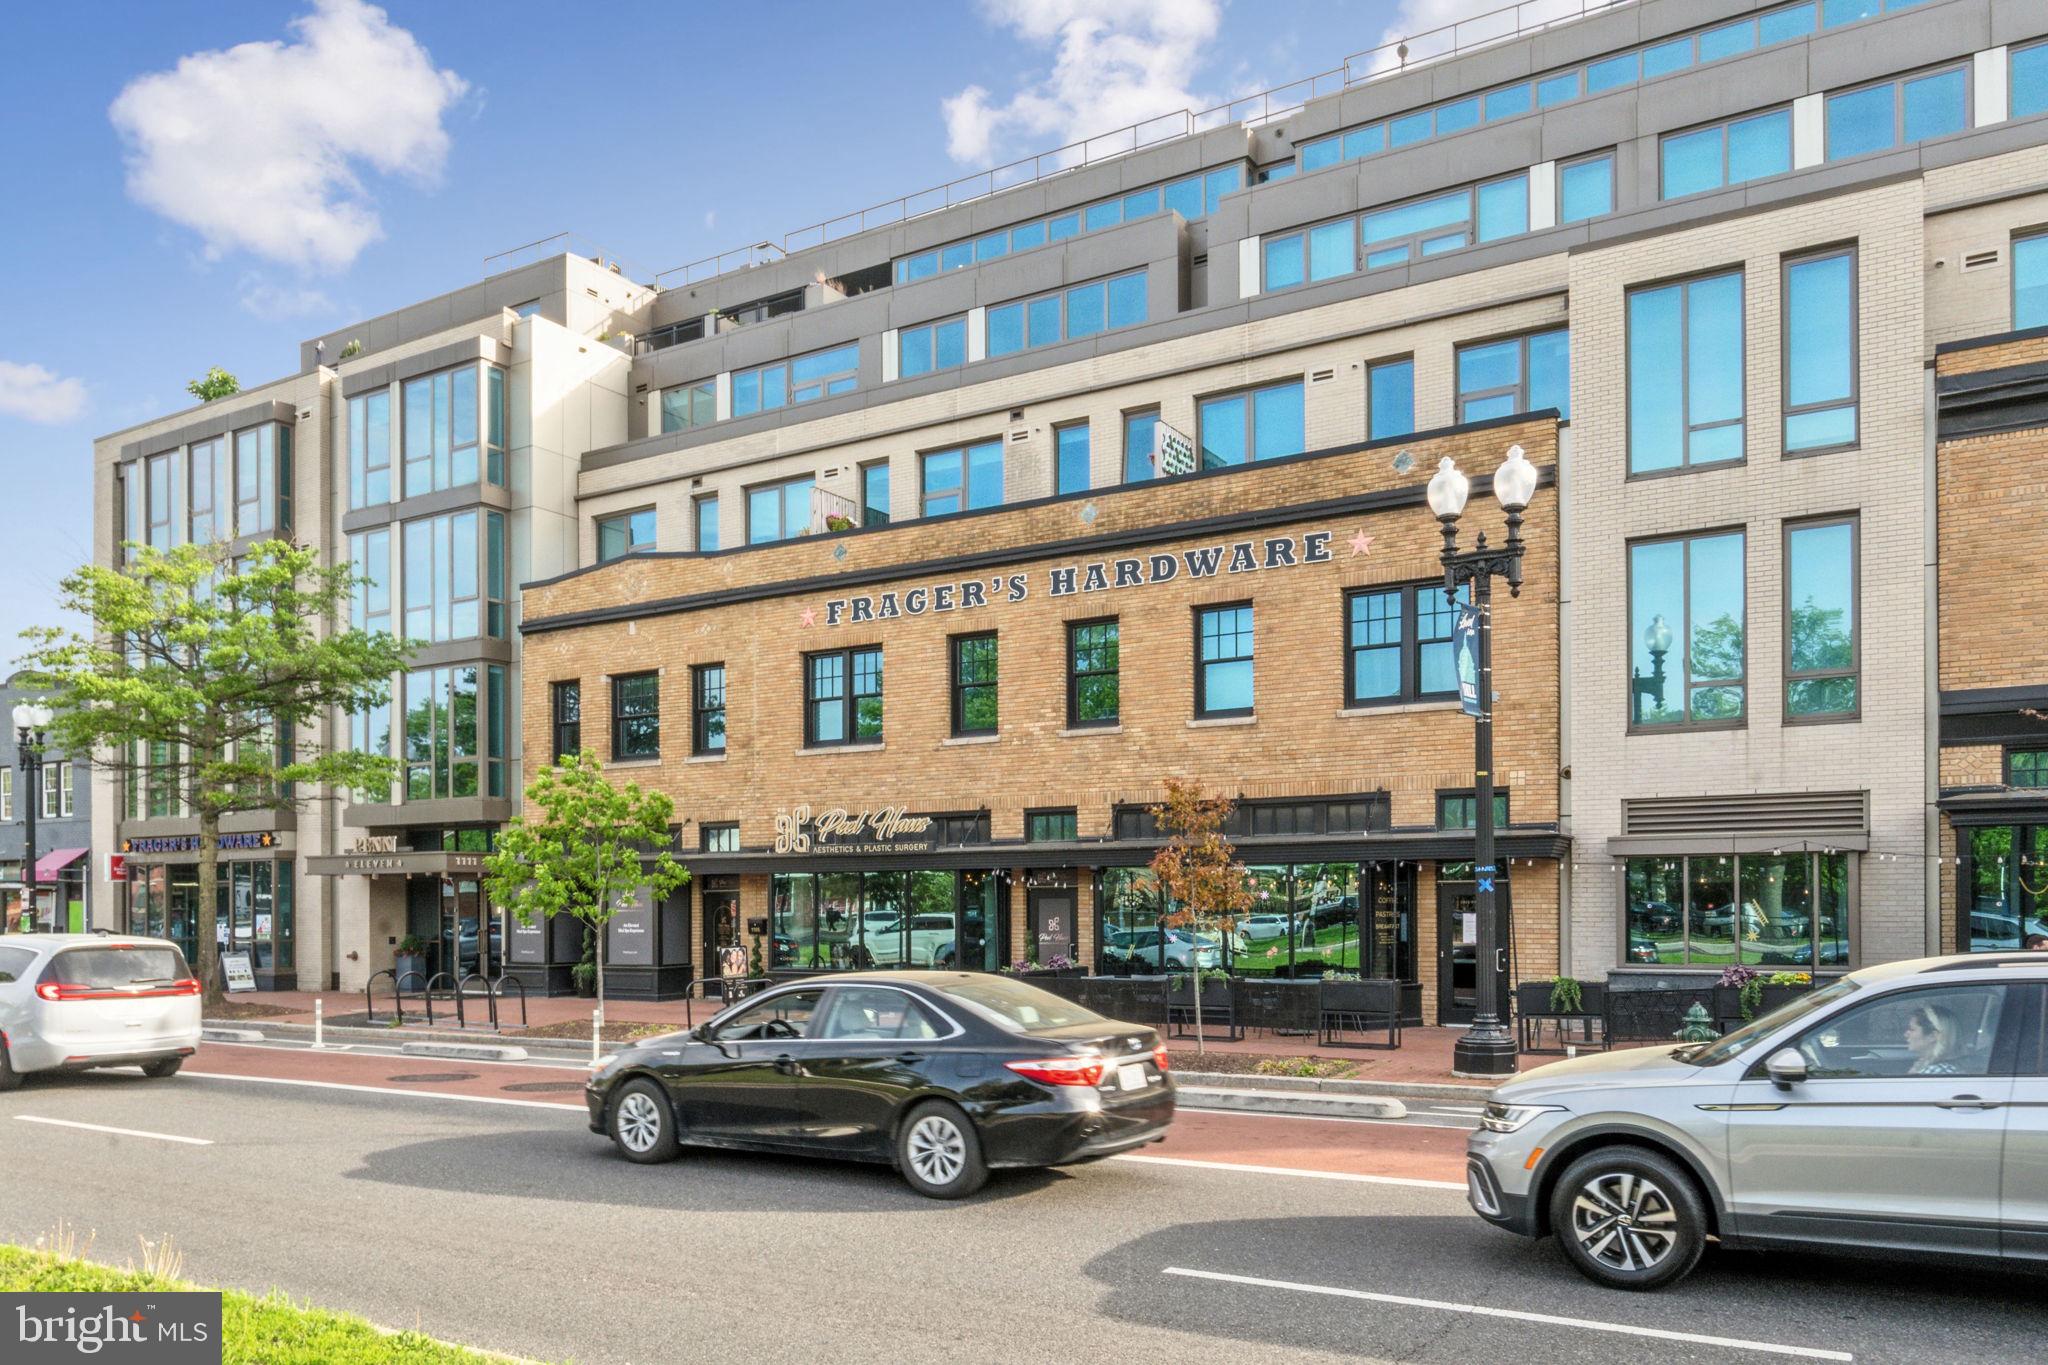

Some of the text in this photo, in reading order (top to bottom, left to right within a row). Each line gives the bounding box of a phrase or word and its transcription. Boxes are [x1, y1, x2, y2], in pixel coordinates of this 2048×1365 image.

[826, 531, 1332, 625] FRAGER'S HARDWARE
[814, 805, 933, 843] Peel Haus
[131, 832, 260, 852] FRAGER'S HDWARE
[352, 835, 398, 853] PENN
[813, 843, 928, 854] AESTHETICS & PLASTIC SURGERY
[353, 858, 393, 869] ELEVEN
[455, 856, 477, 866] 1111
